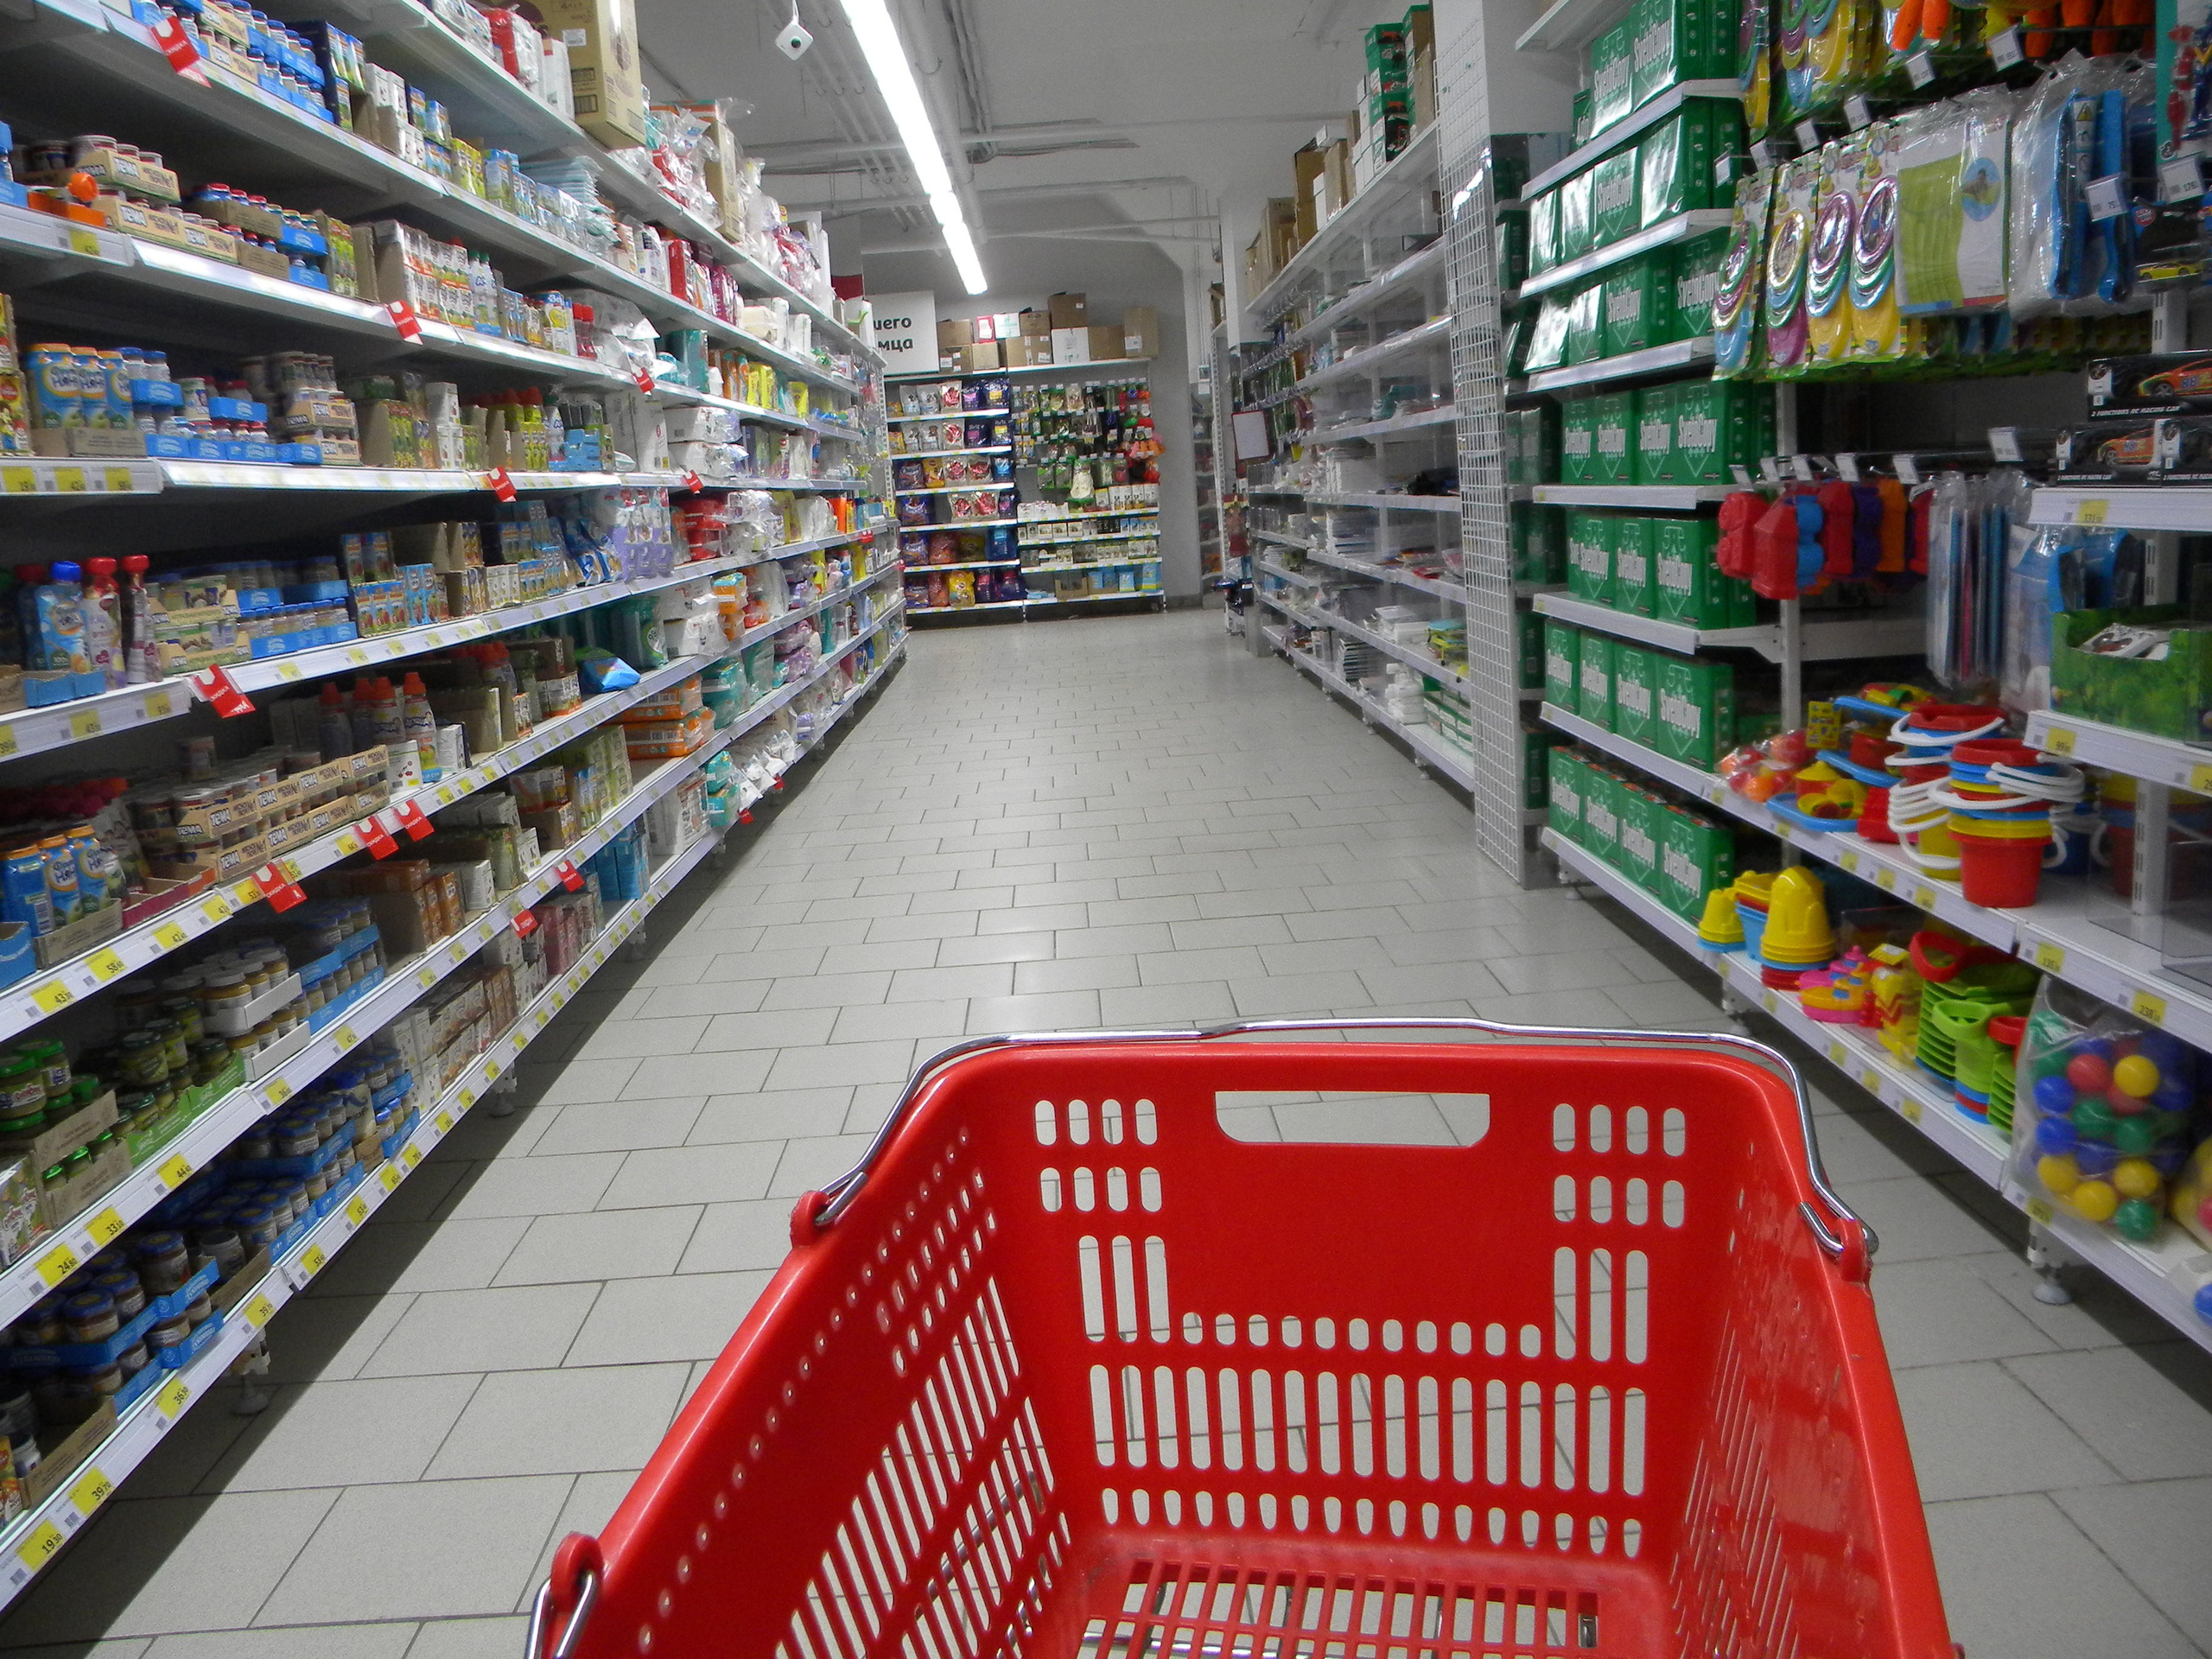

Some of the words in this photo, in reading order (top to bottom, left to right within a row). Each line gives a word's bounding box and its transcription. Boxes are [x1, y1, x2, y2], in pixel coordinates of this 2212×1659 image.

[878, 338, 913, 353] мца
[1678, 412, 1717, 453] SvetoCopy
[405, 816, 423, 830] СКИДКА
[366, 834, 385, 847] СКИДКА
[266, 883, 286, 898] СКИДКА
